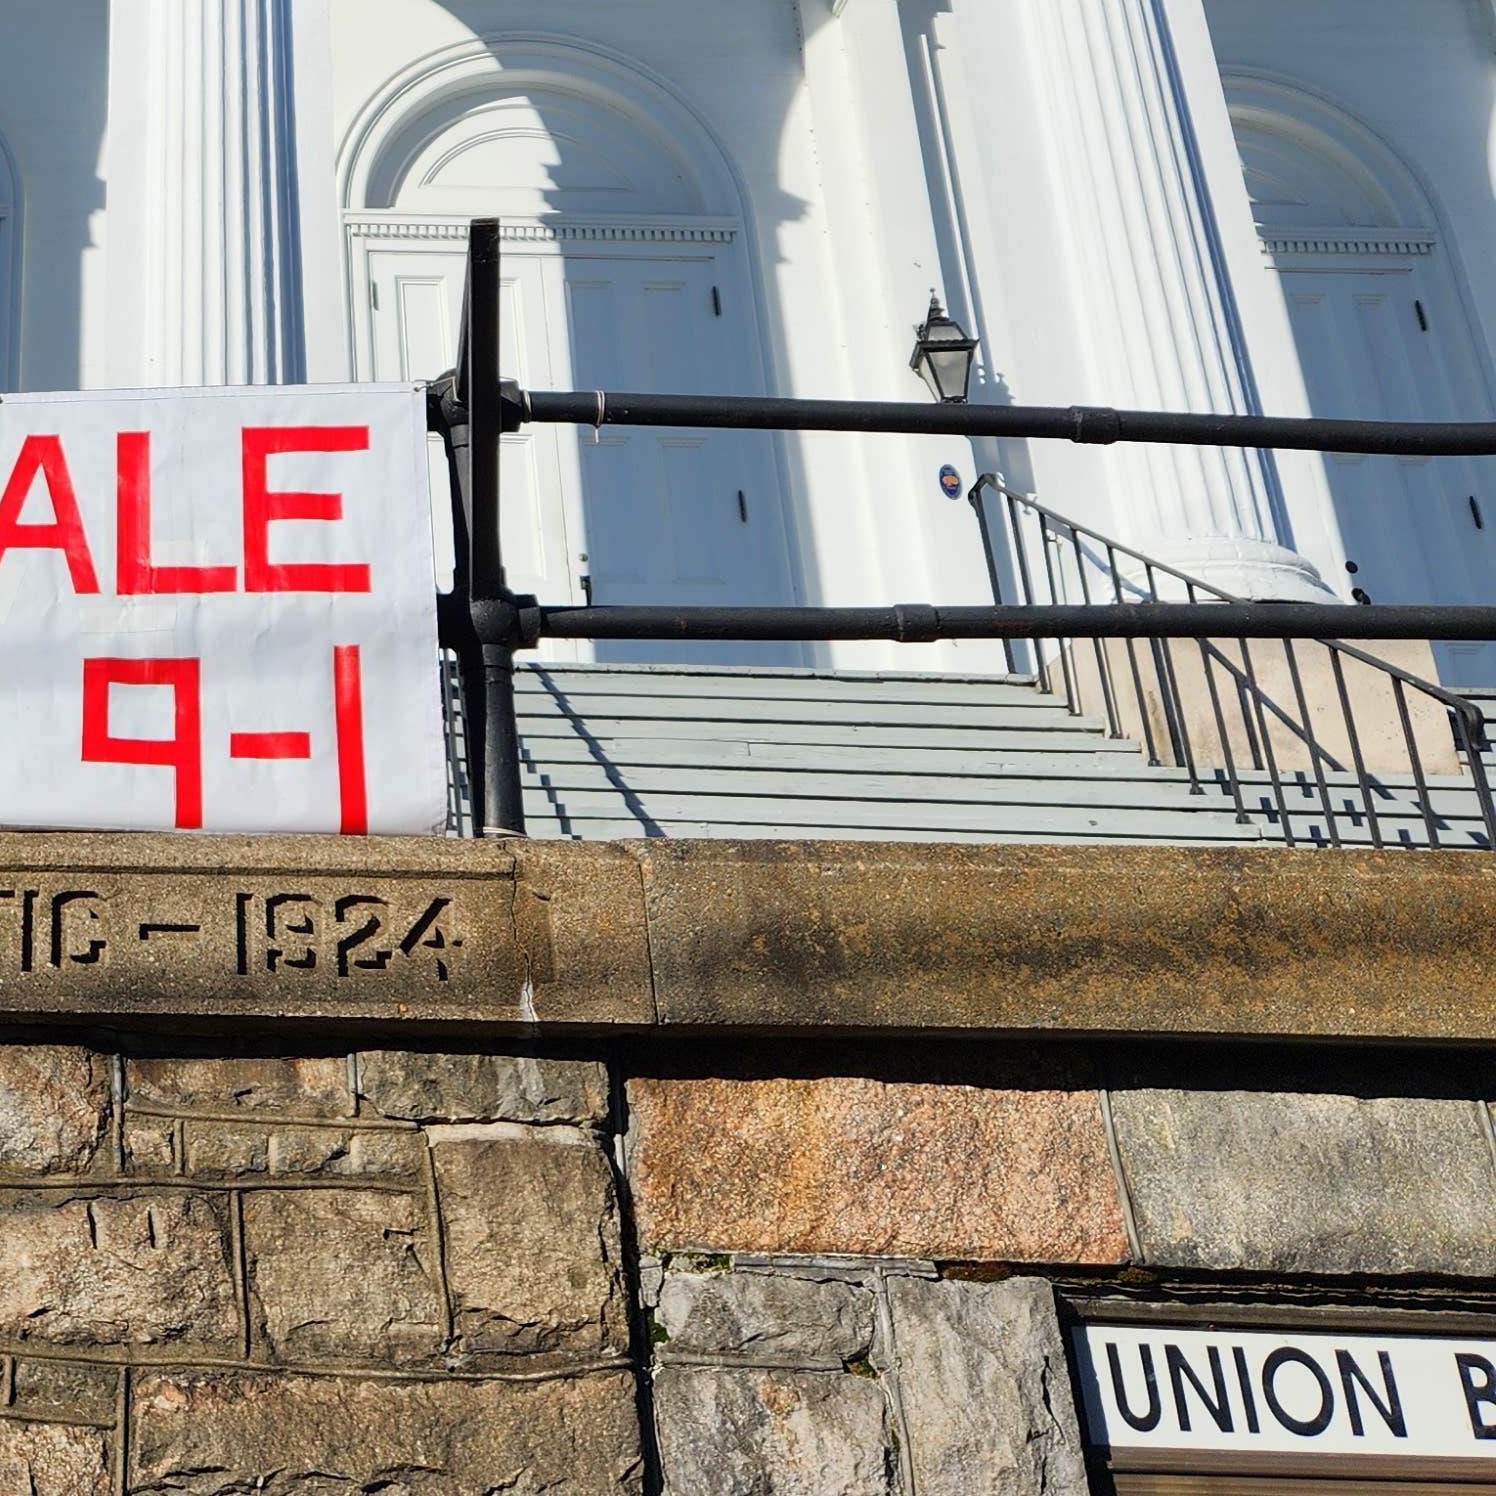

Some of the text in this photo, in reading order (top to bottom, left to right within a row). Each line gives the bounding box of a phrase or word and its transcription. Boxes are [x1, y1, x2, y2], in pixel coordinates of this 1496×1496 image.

[81, 644, 370, 836] 9-1
[235, 892, 465, 982] 1924
[1105, 1342, 1408, 1438] UNION
